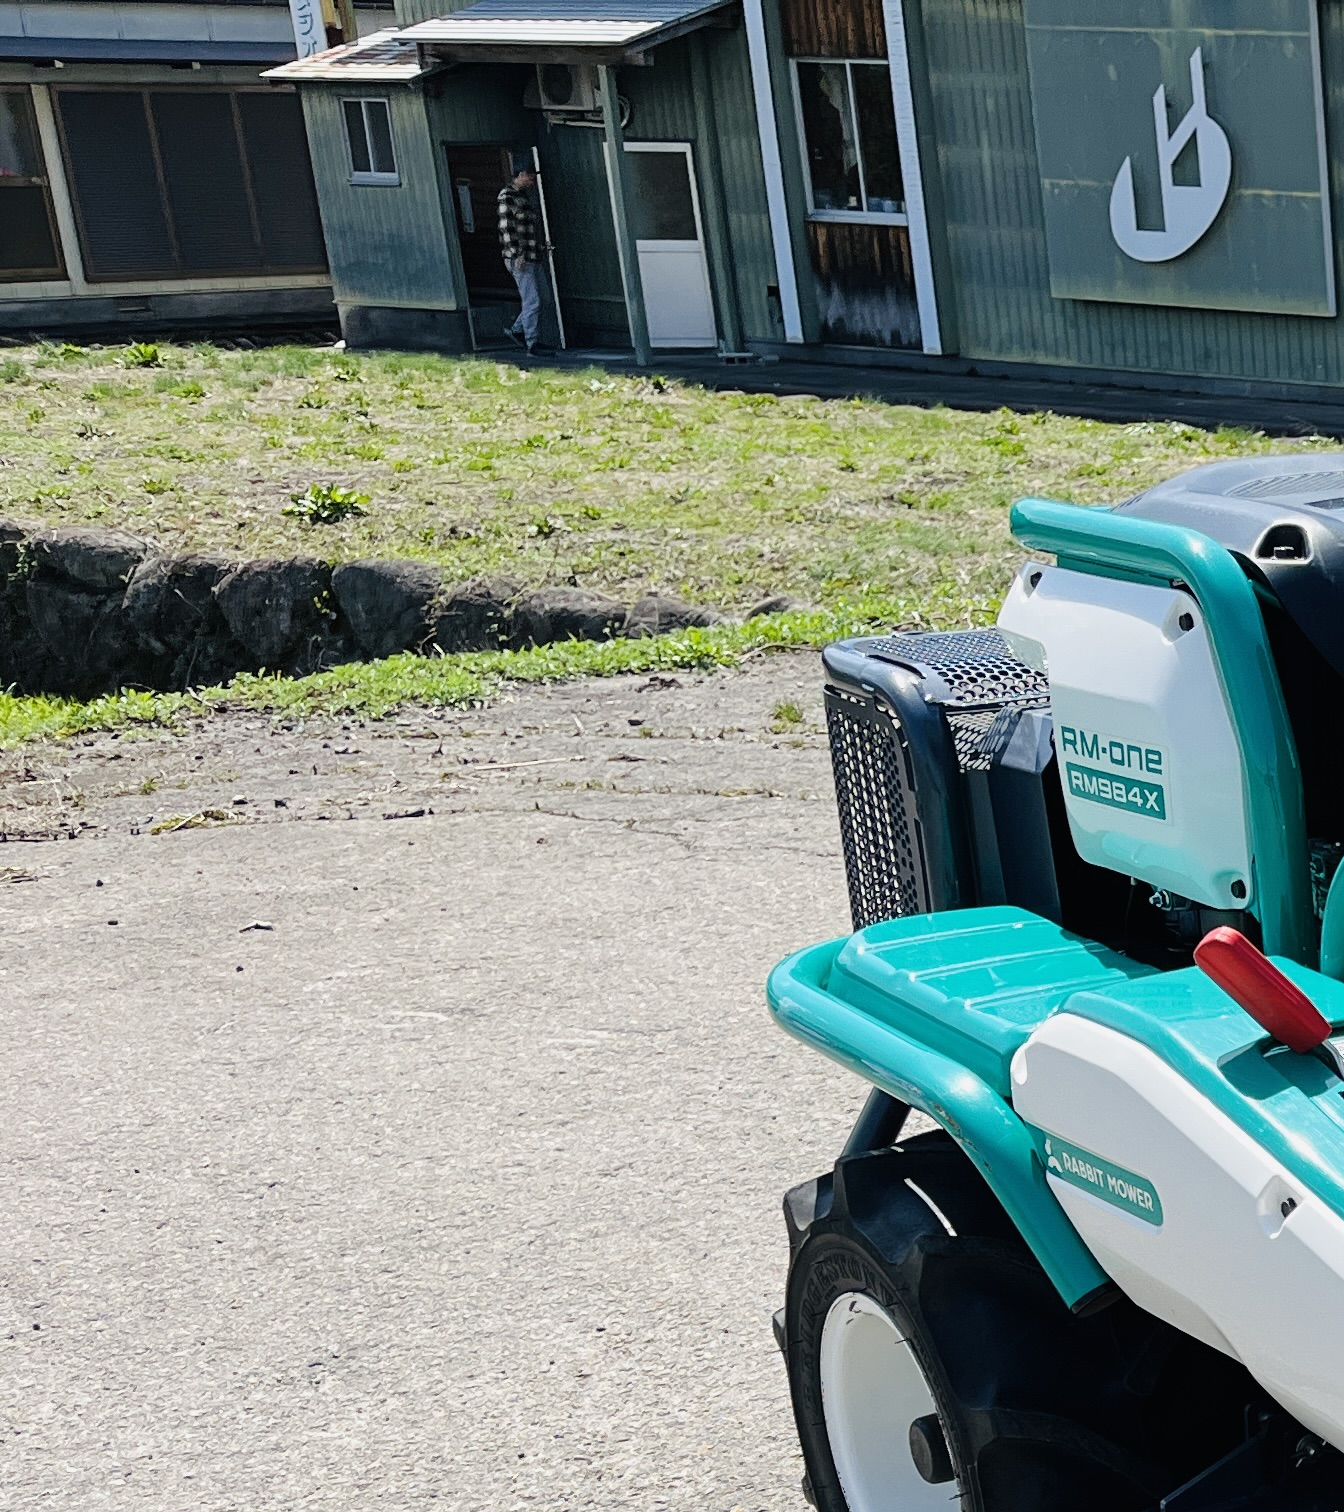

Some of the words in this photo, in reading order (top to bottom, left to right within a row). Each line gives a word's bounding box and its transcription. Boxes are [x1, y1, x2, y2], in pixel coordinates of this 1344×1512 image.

[1071, 770, 1160, 811] RM984X
[1062, 1152, 1104, 1188] RABBIT
[1106, 1174, 1154, 1212] MOWER
